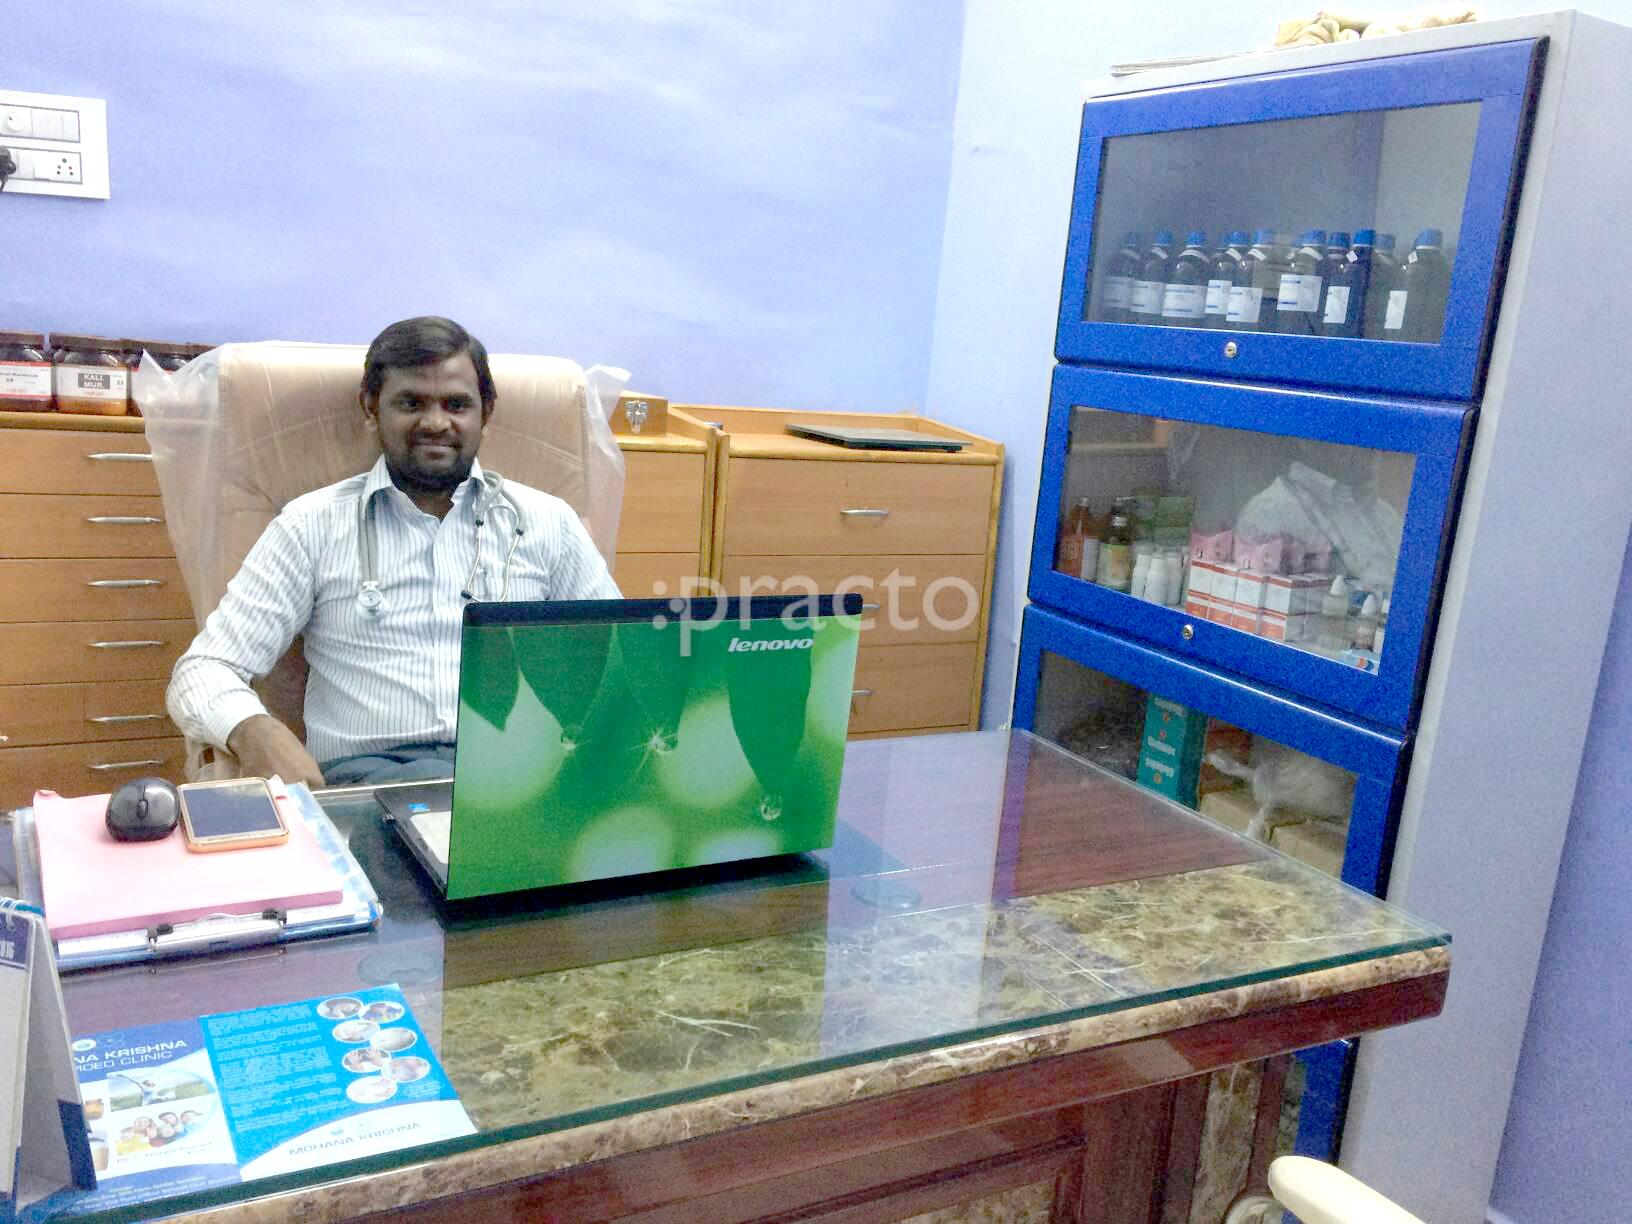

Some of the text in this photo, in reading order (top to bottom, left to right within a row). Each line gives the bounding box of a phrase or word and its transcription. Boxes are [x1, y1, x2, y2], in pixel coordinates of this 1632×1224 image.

[727, 637, 814, 653] lenovo
[105, 1040, 188, 1060] KRISHNA
[120, 1050, 173, 1065] CLINIC
